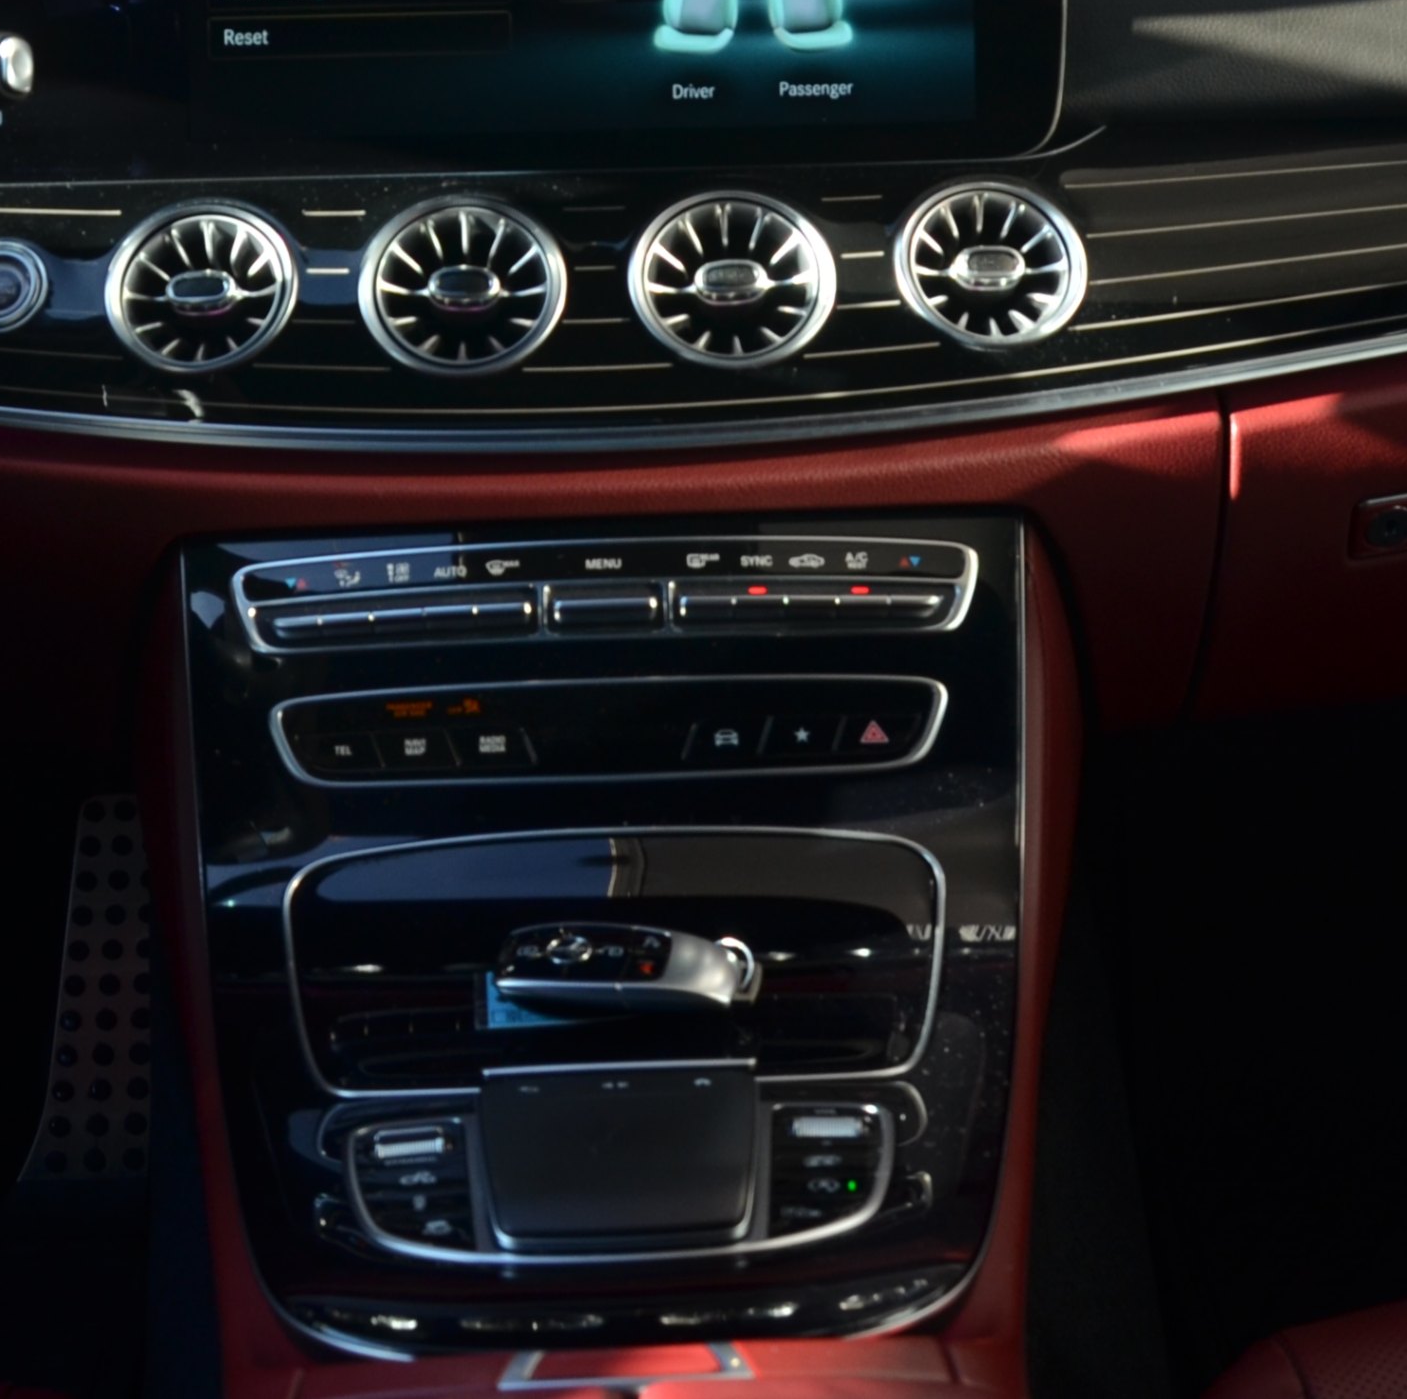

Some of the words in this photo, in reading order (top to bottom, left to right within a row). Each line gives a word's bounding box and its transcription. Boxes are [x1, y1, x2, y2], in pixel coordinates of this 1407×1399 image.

[223, 29, 269, 46] Reset
[671, 82, 715, 99] Driver
[779, 80, 854, 100] Passenger
[740, 555, 773, 567] SYNC
[845, 551, 868, 562] A/C
[584, 557, 622, 570] MENU
[433, 565, 468, 579] AUTO
[334, 745, 353, 756] TEL
